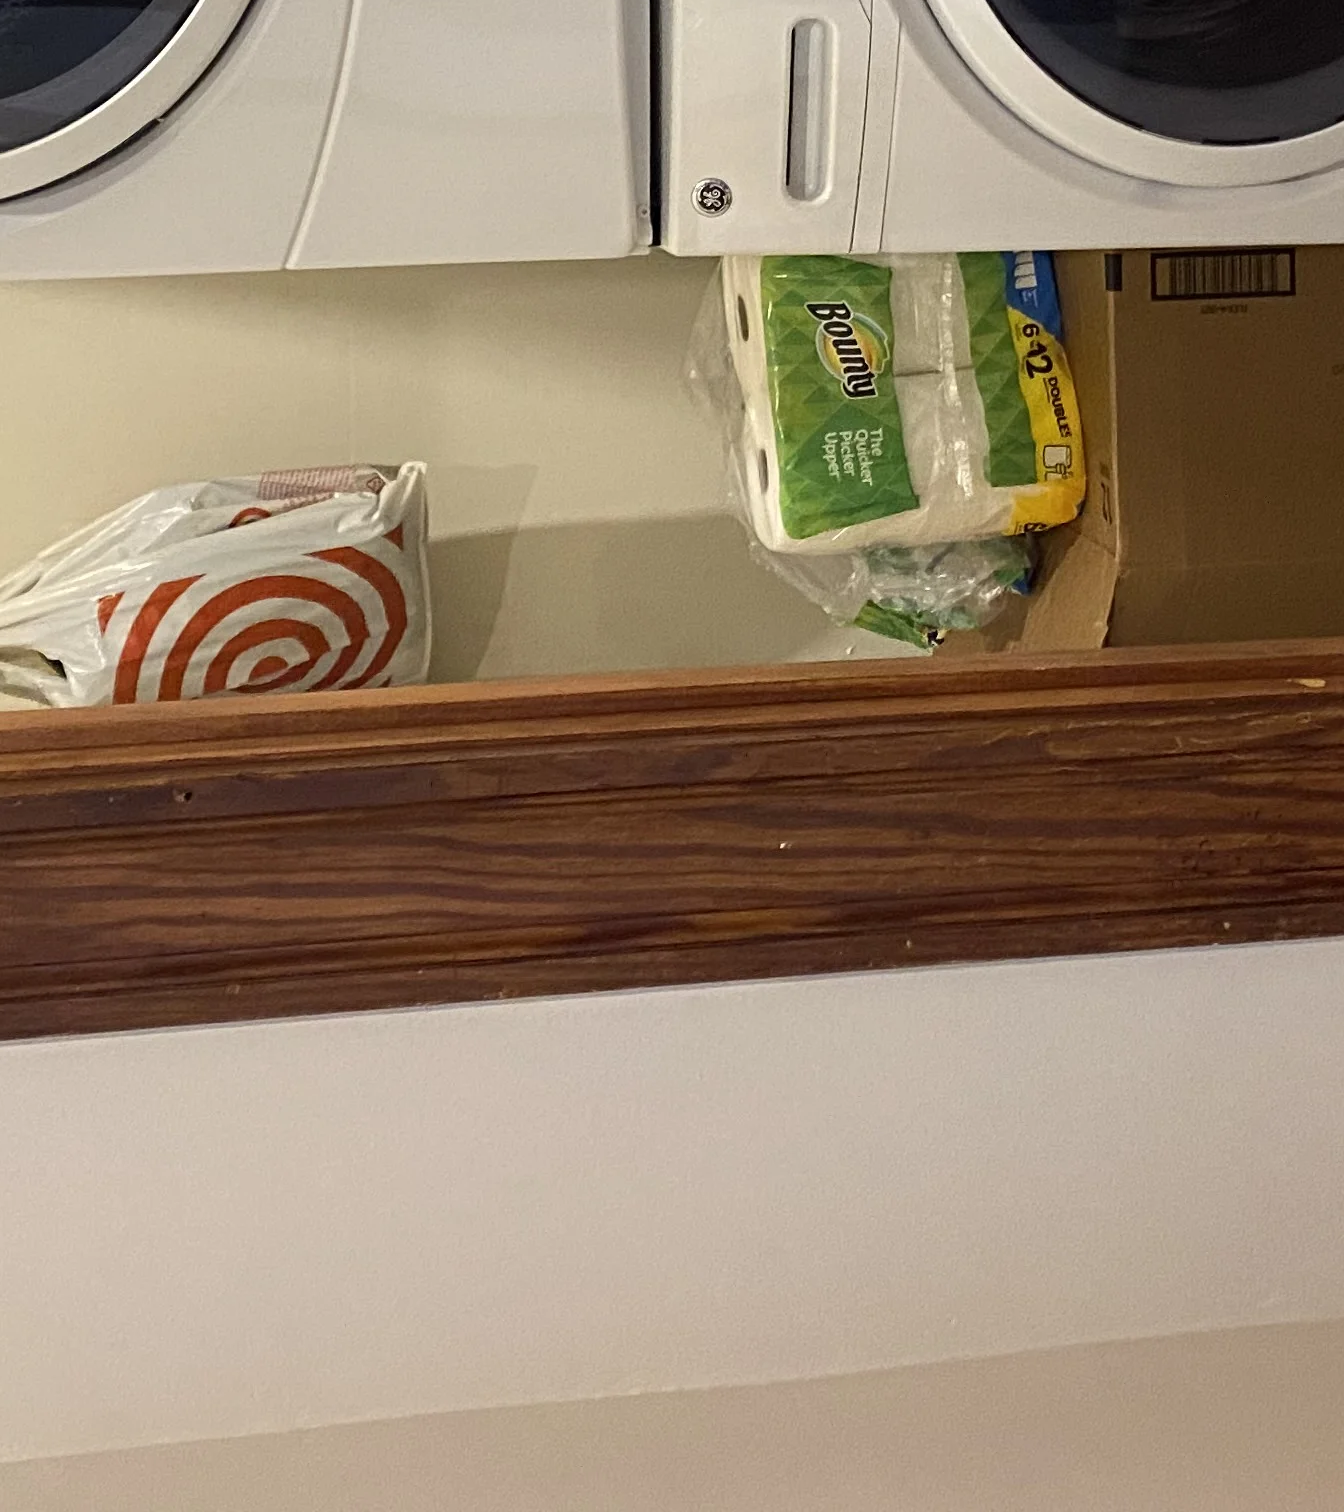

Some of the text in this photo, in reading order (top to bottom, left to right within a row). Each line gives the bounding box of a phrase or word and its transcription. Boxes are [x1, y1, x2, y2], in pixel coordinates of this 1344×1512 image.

[804, 301, 878, 398] Bounty
[822, 432, 840, 482] Upper
[840, 431, 855, 476] Picker
[855, 429, 873, 486] Quicker
[870, 428, 884, 456] The
